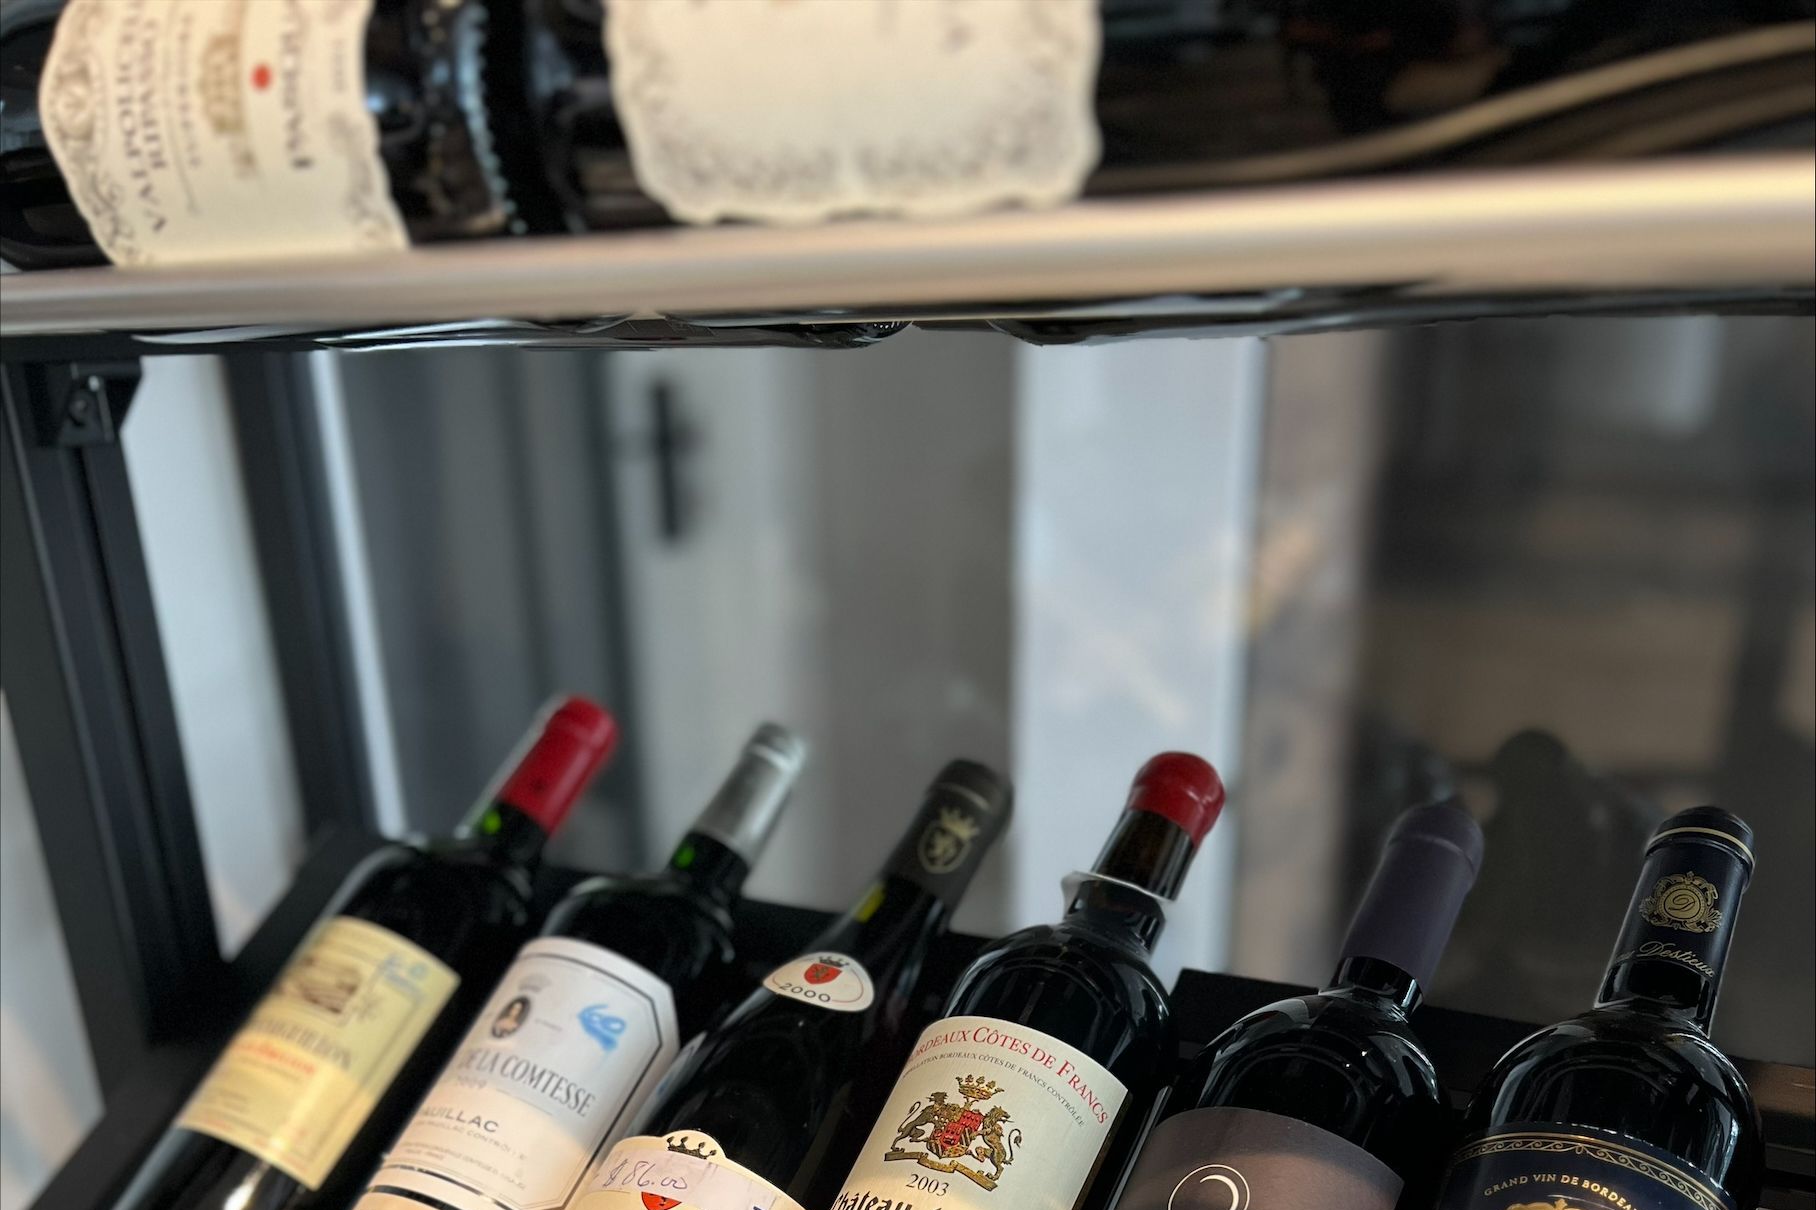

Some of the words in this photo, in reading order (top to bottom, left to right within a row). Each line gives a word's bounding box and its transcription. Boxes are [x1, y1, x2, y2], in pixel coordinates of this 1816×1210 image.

[1635, 941, 1716, 978] Destieux
[779, 982, 831, 1003] 2000
[499, 1052, 596, 1118] COMTESSE
[939, 1051, 978, 1061] BORDEAUX
[978, 1052, 1006, 1067] CÔTES
[1004, 1061, 1017, 1071] DE
[1017, 1066, 1047, 1087] FRANCS
[973, 1026, 1032, 1056] CÔTES
[1030, 1047, 1058, 1070] DE
[1055, 1060, 1110, 1125] FRANCS
[904, 1172, 951, 1197] 2003
[1483, 1175, 1529, 1197] GRAND
[1532, 1173, 1557, 1184] VIN
[1560, 1174, 1579, 1187] DE
